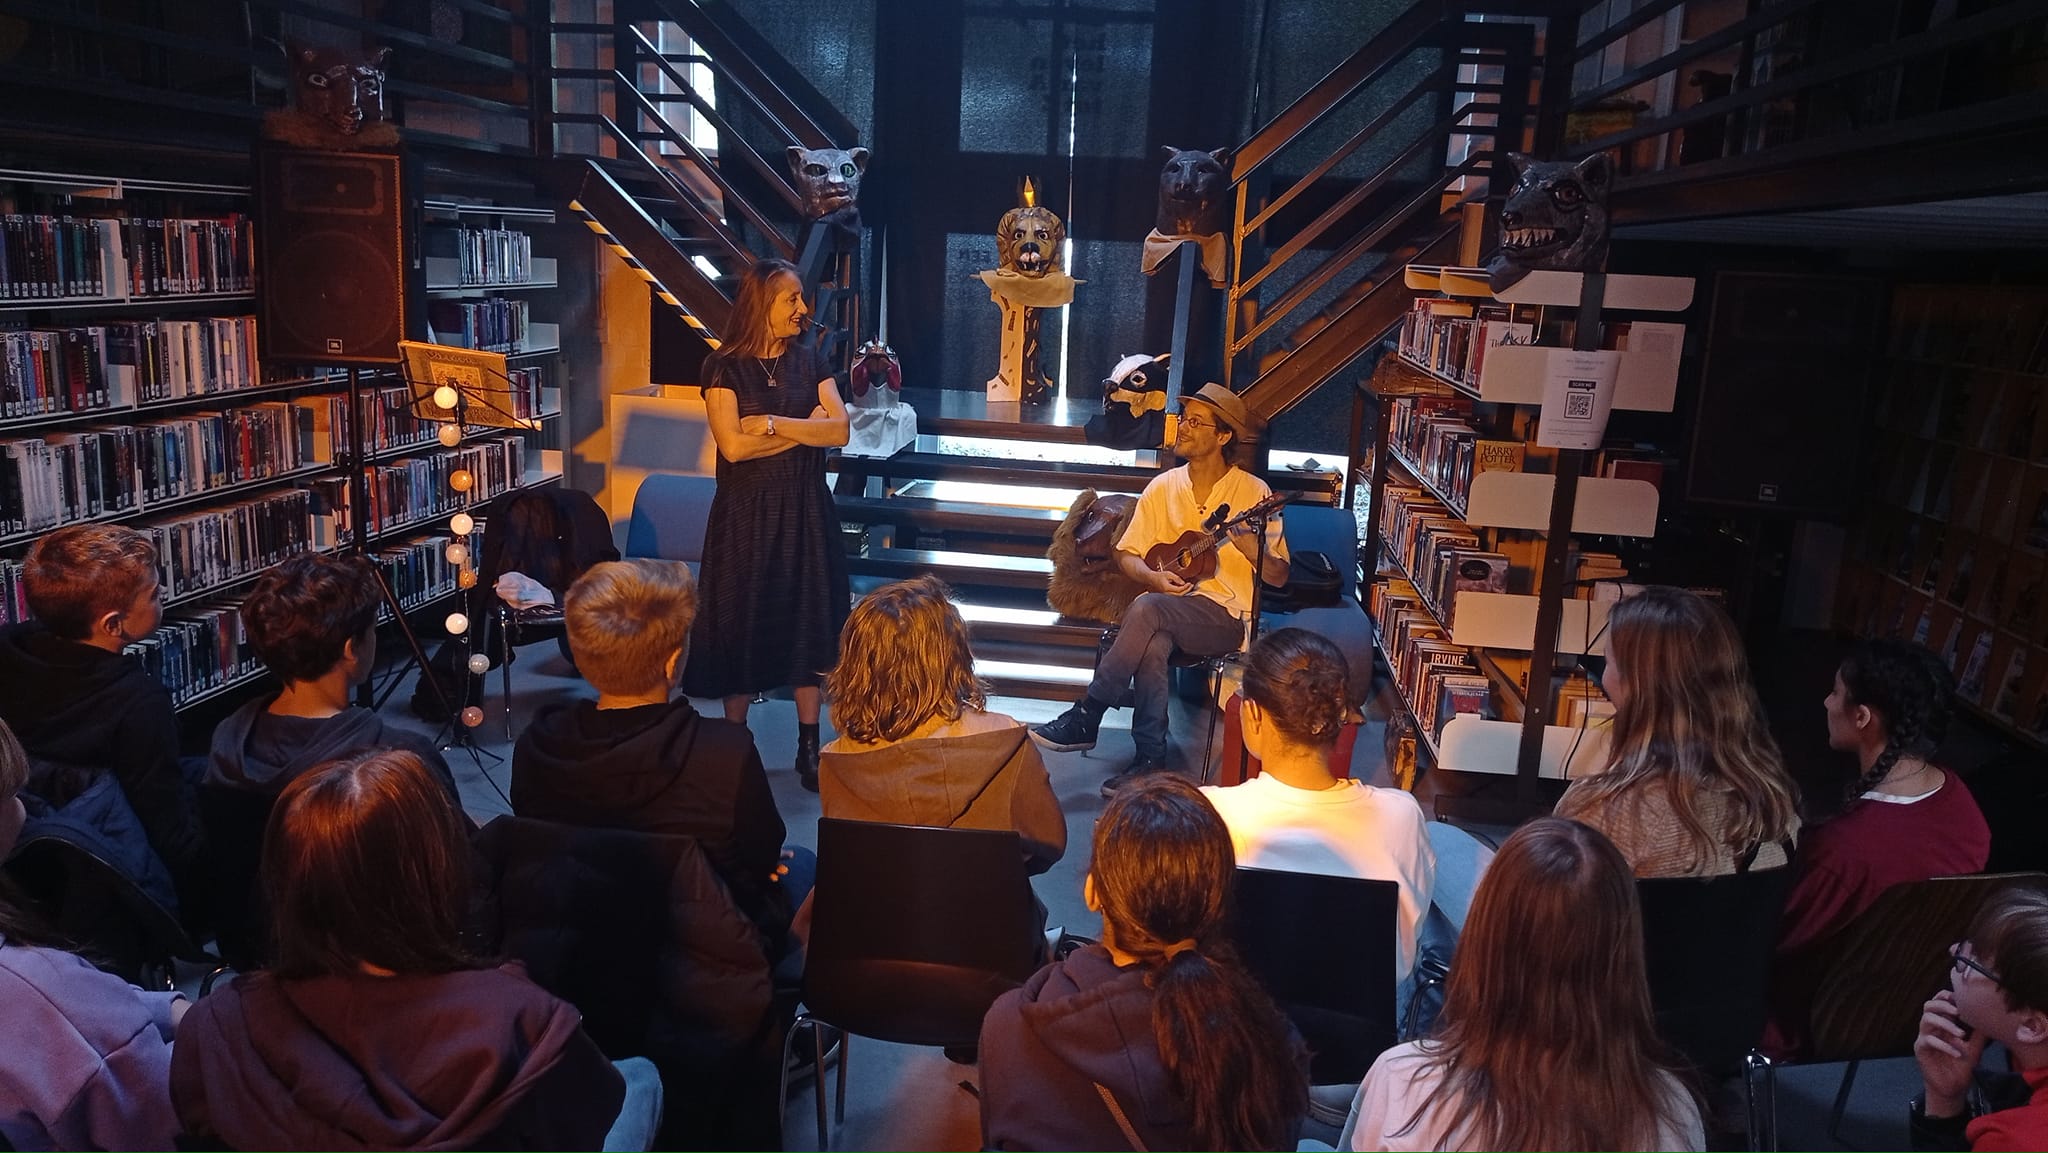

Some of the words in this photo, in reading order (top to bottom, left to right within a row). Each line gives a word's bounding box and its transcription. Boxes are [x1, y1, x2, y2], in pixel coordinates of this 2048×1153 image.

[1483, 445, 1513, 456] HARRY
[1480, 453, 1516, 465] POTTER
[1431, 653, 1465, 666] IRVINE
